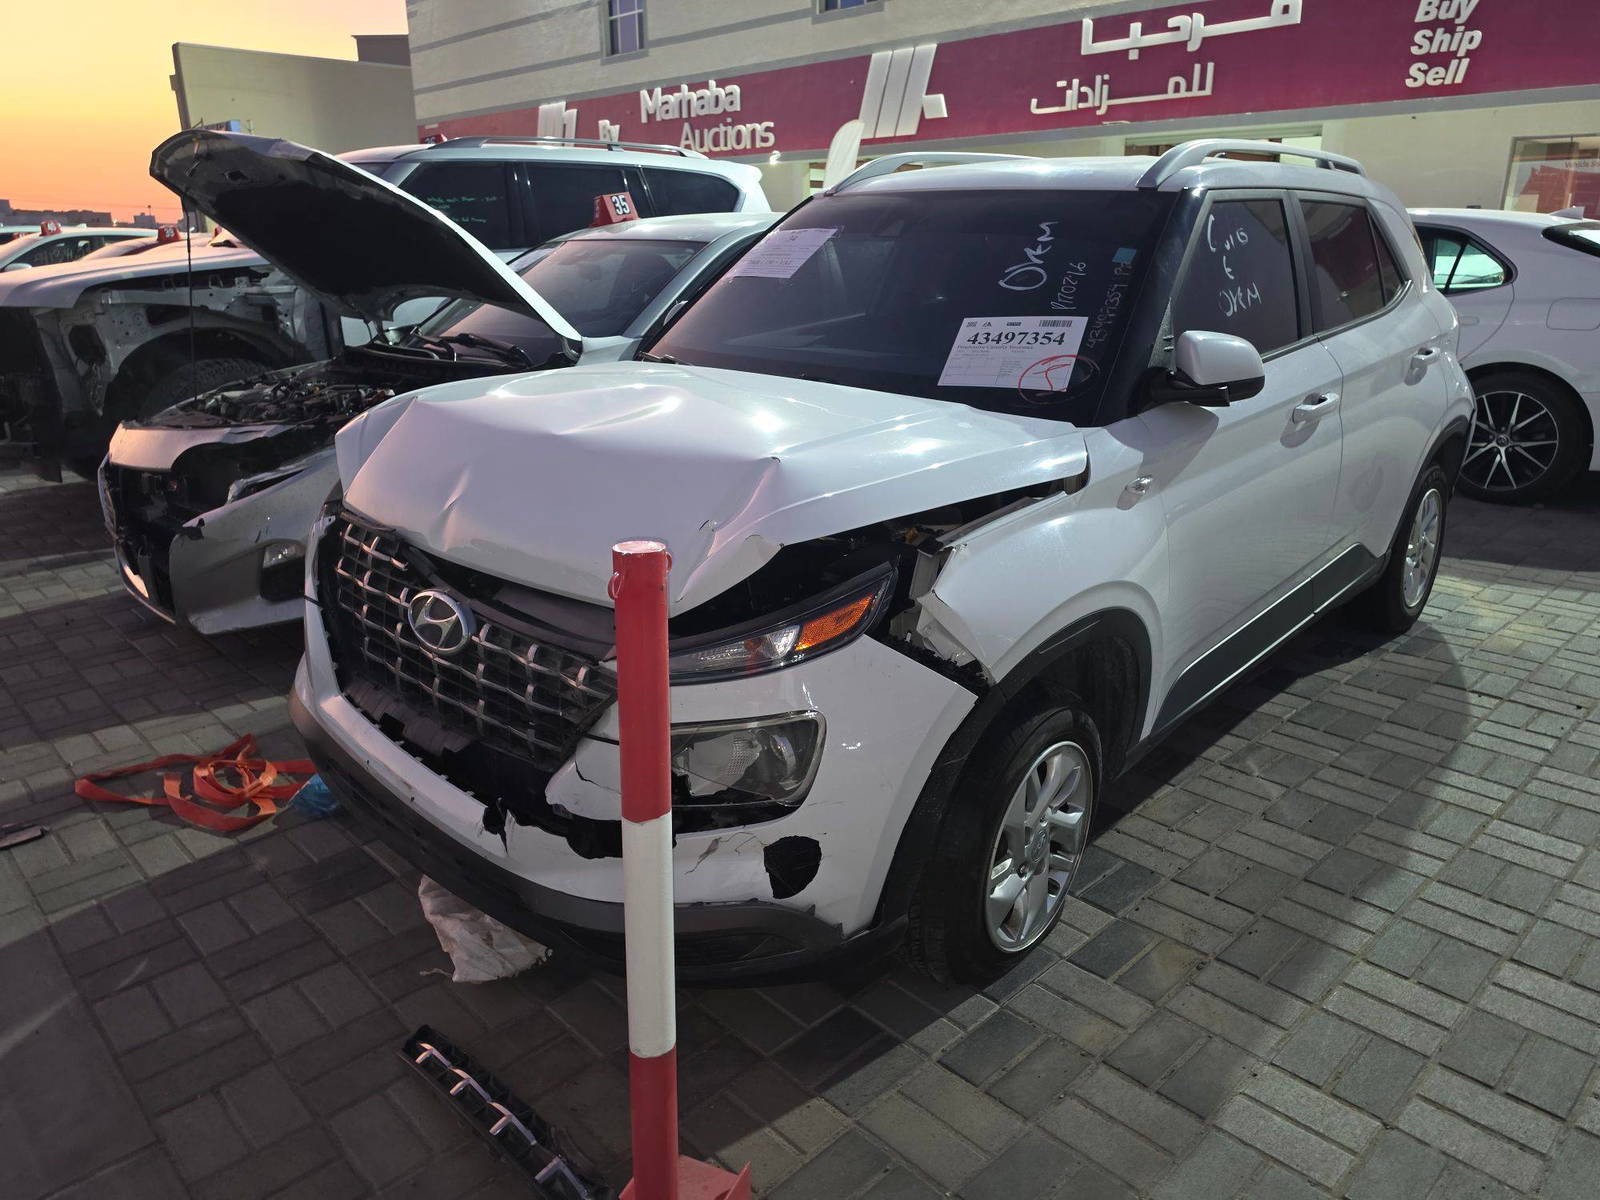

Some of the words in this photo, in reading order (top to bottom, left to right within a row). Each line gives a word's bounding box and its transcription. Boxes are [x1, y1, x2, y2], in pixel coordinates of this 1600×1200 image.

[1414, 0, 1479, 24] Buy
[1410, 26, 1482, 57] Ship
[1405, 58, 1470, 87] Sell
[640, 80, 741, 123] Marhaba
[679, 118, 775, 153] Auctions
[611, 194, 631, 215] 35
[967, 331, 1066, 346] 43497354
